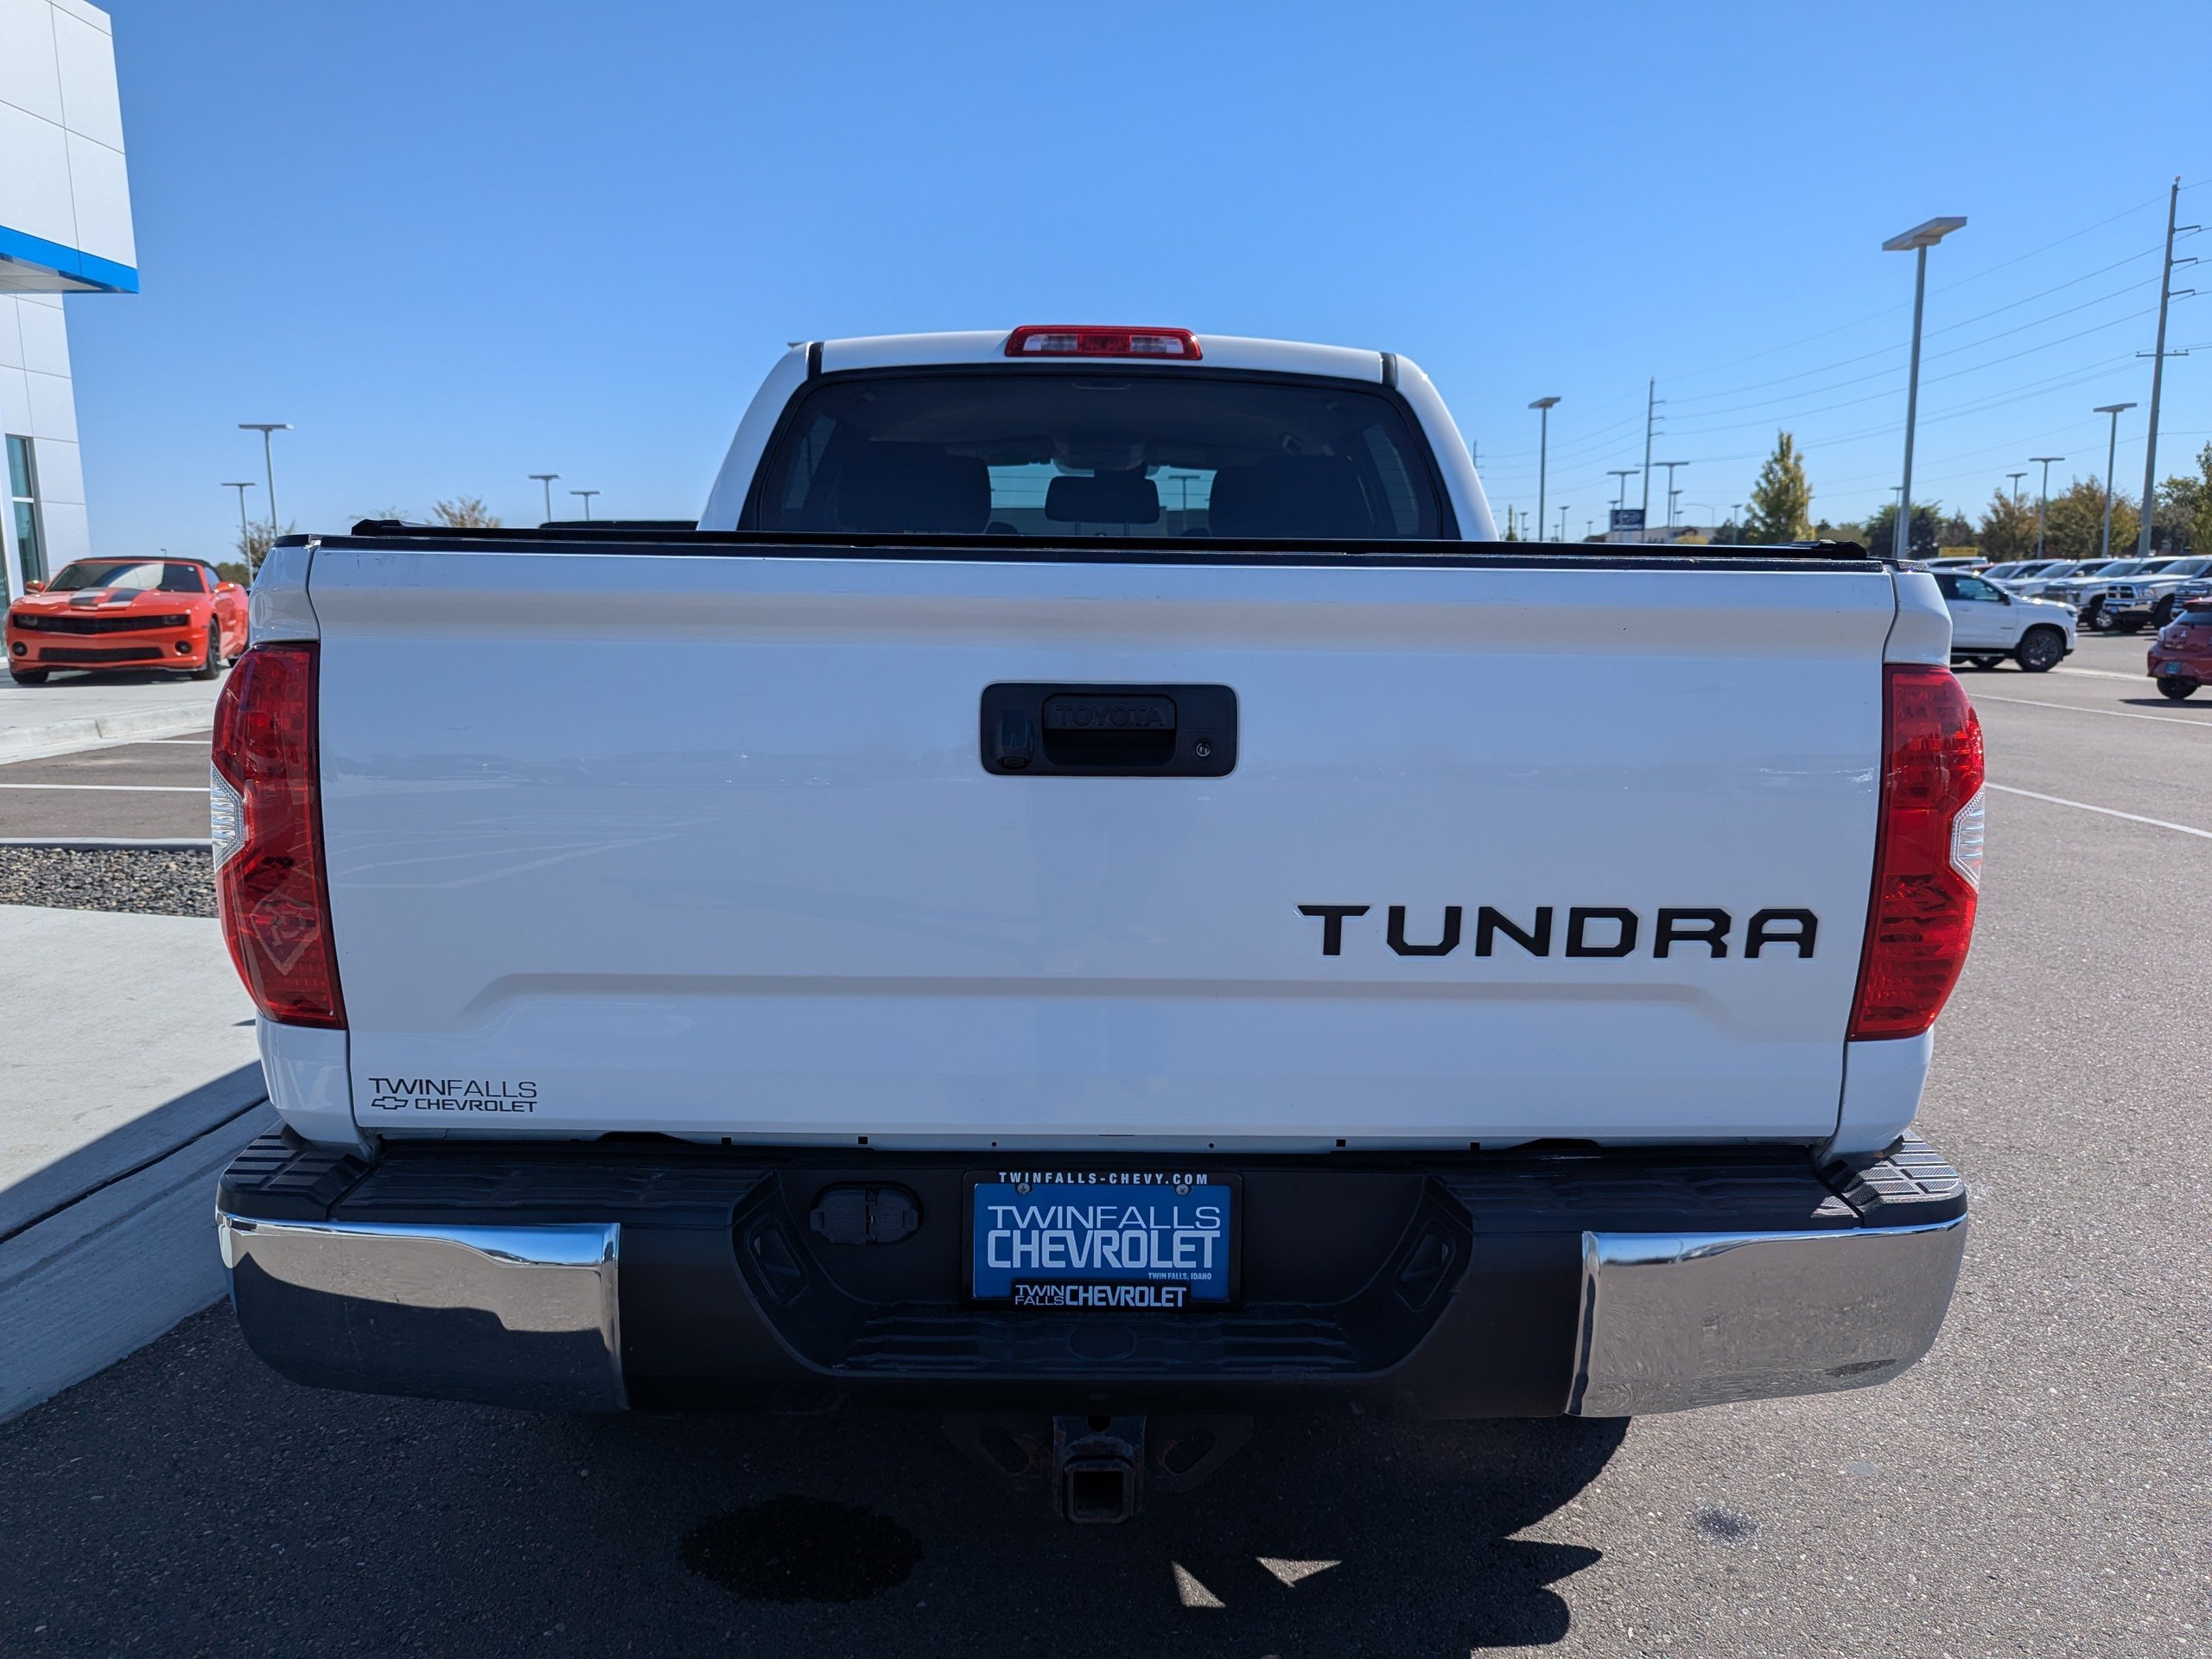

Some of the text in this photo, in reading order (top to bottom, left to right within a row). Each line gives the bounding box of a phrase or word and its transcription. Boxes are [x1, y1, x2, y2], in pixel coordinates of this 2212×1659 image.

[1054, 705, 1165, 727] TOYOTA
[1298, 905, 1818, 959] TUNDRA
[415, 1098, 538, 1112] CHEVROLET
[999, 1172, 1208, 1185] TWINFALLS-CHEVY.COM
[988, 1230, 1221, 1268] CHEVROLET
[1015, 1285, 1065, 1296] TWIN
[1065, 1286, 1187, 1307] CHEVROLET
[1014, 1296, 1065, 1306] FALLS
